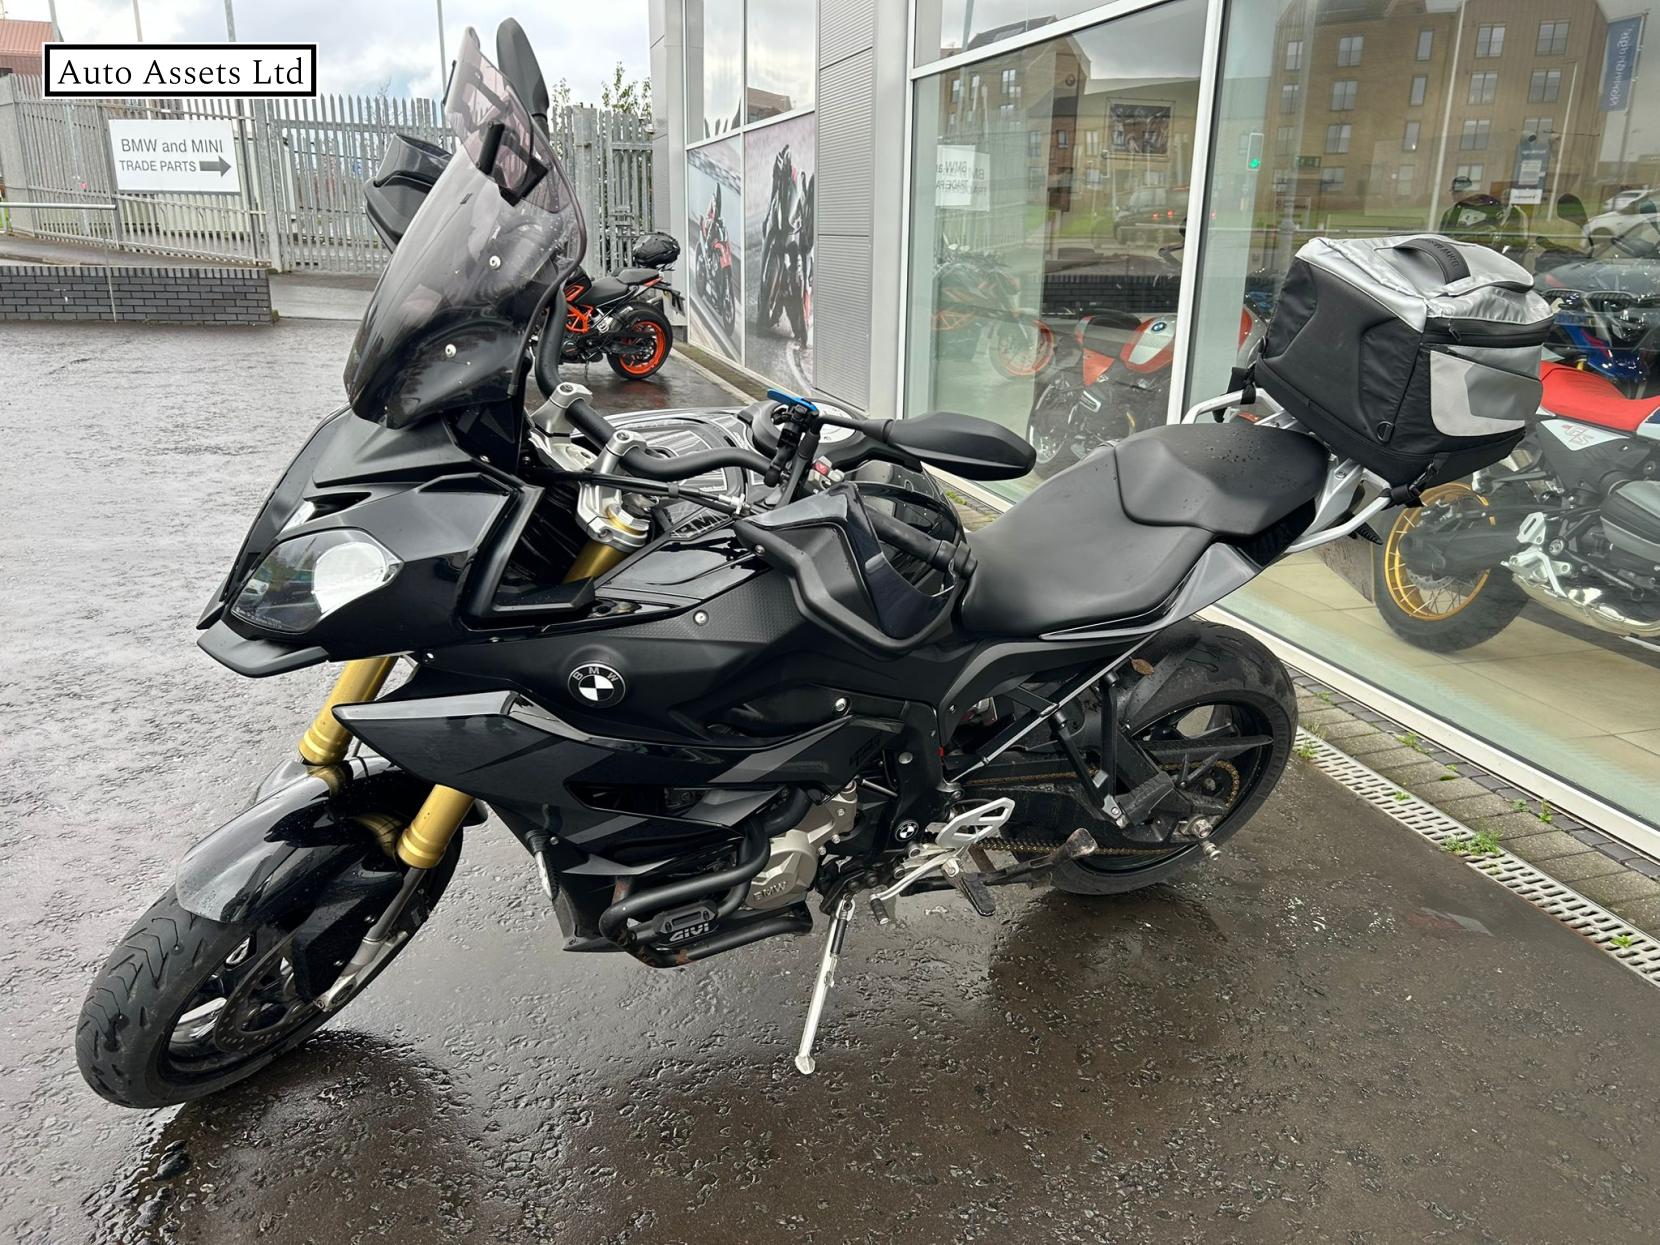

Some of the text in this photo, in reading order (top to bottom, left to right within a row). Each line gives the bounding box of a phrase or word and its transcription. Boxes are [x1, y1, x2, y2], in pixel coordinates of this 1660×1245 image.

[121, 138, 223, 153] BMW and MINI
[119, 159, 197, 173] TRADE PARTS
[572, 666, 619, 682] BMW
[669, 922, 710, 942] GIVI
